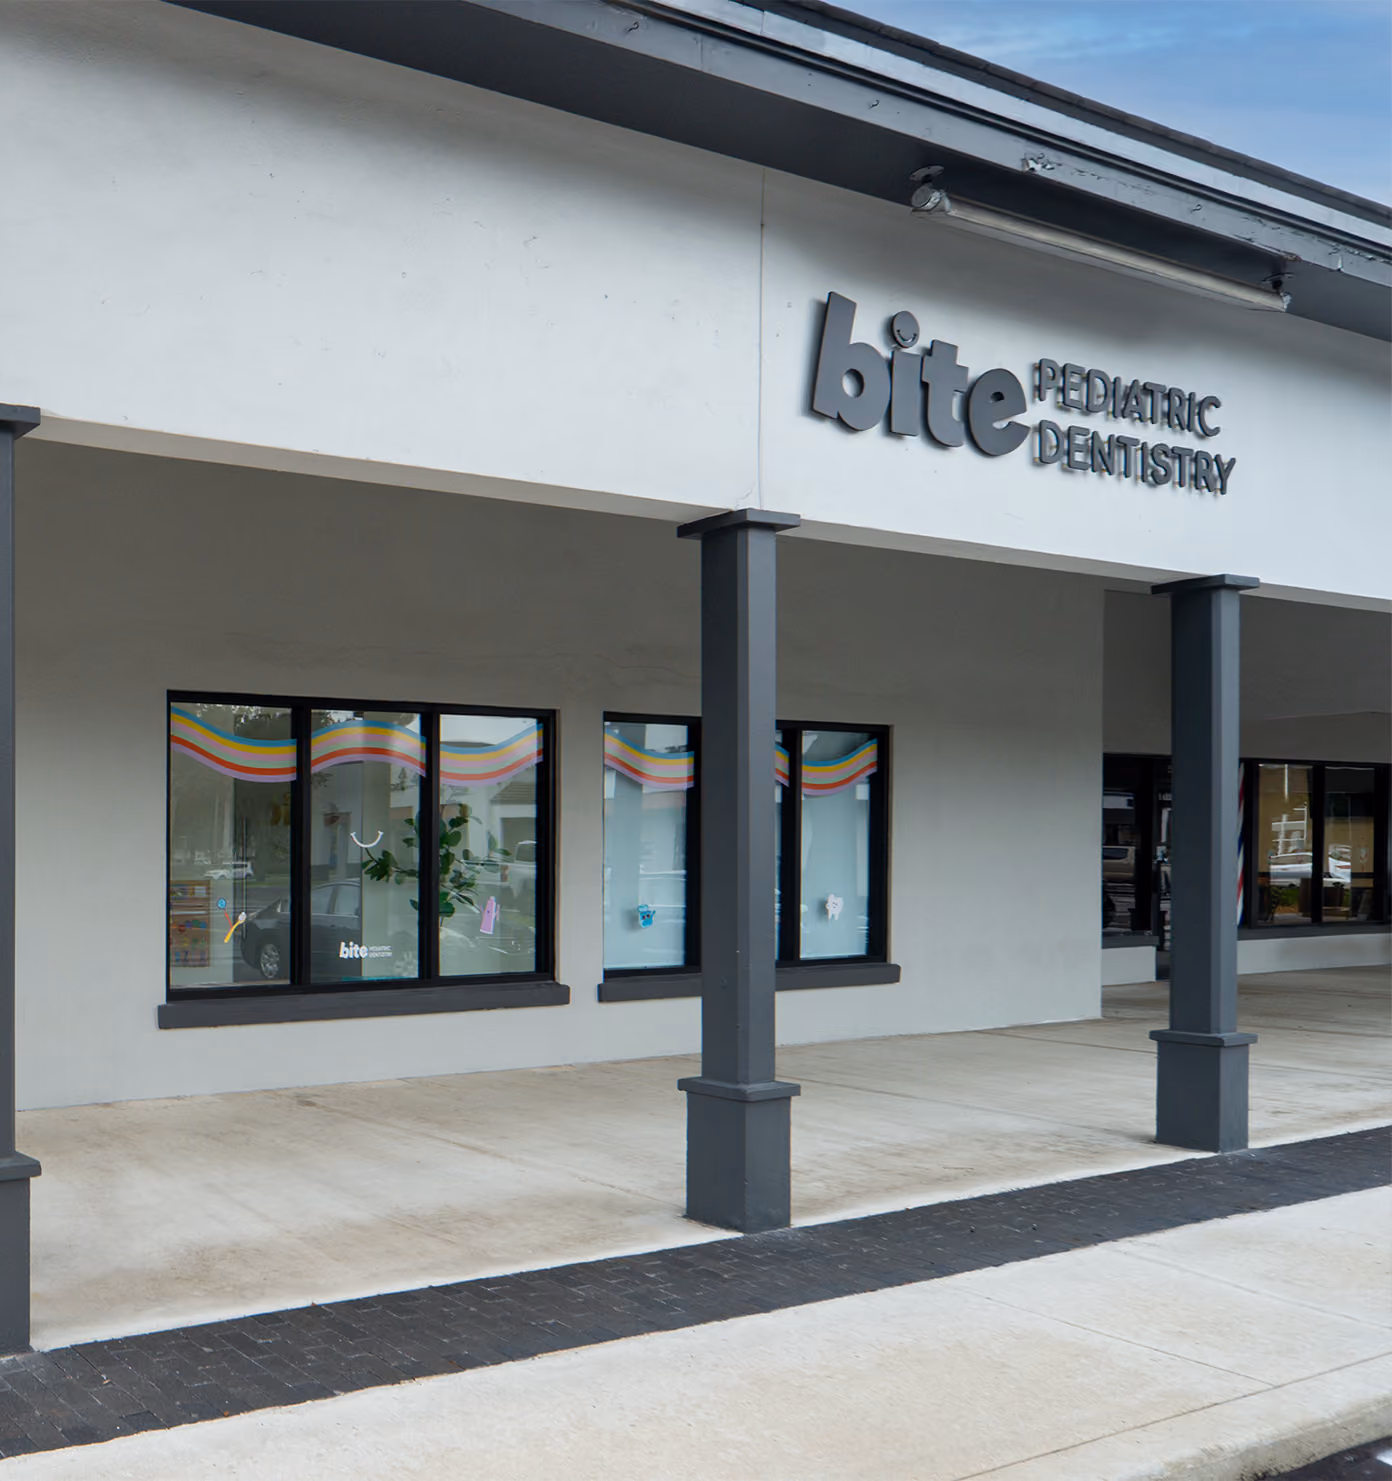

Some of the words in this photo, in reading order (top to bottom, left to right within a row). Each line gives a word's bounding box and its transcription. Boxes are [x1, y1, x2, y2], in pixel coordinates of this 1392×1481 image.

[811, 290, 1031, 457] bite
[1036, 357, 1222, 438] PEDIATRIC
[1036, 419, 1237, 496] DENTISTRY
[339, 941, 369, 958] bite
